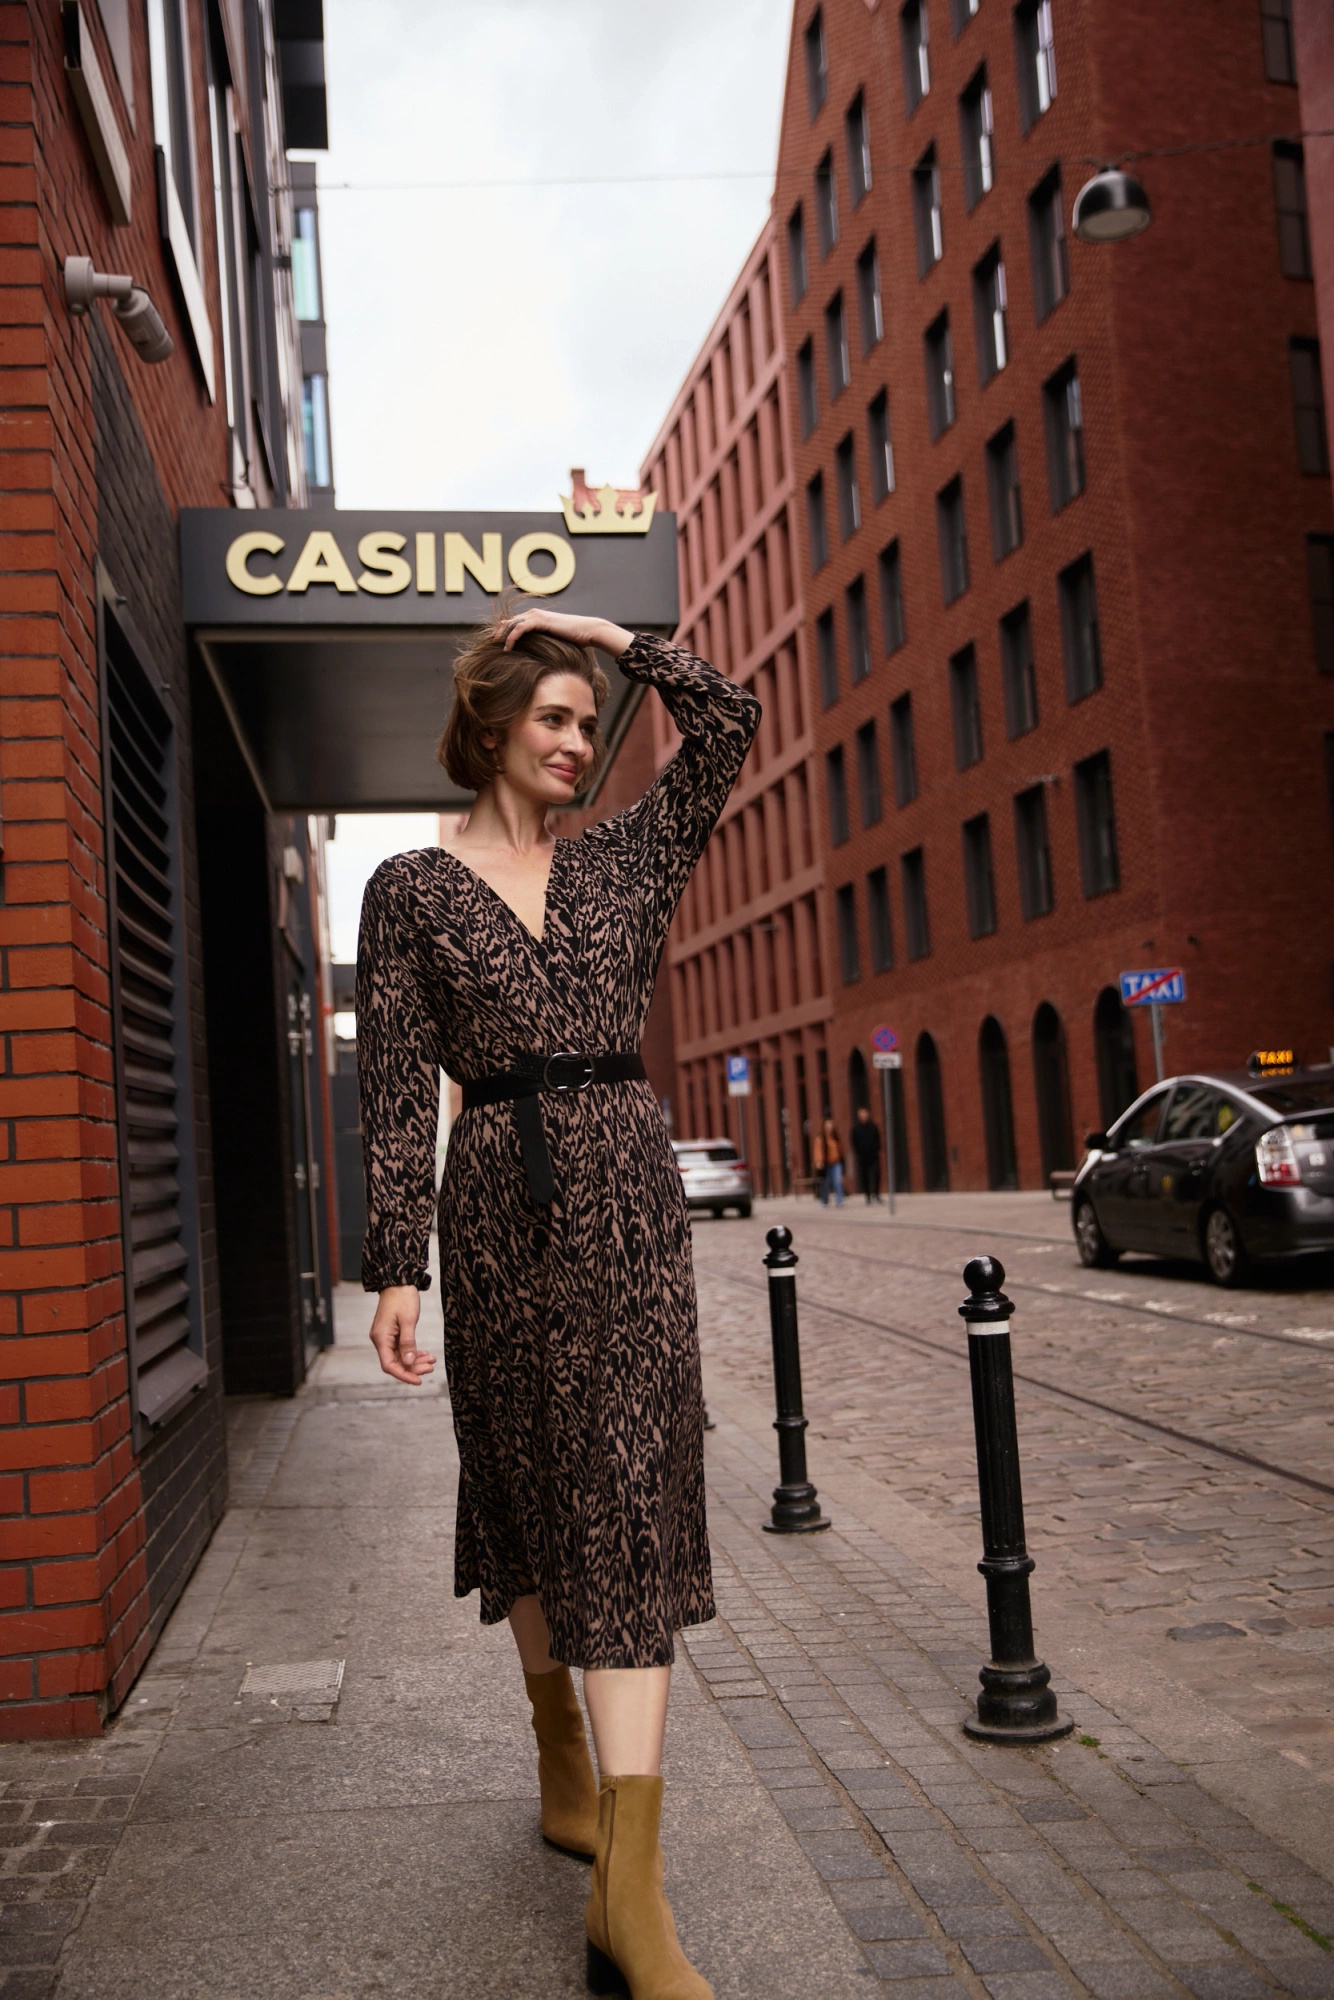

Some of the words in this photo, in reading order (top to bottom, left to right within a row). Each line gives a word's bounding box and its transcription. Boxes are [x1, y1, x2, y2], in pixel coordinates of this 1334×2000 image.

[225, 531, 576, 595] CASINO
[1124, 975, 1179, 998] TAXI
[1258, 1050, 1293, 1065] TAXI
